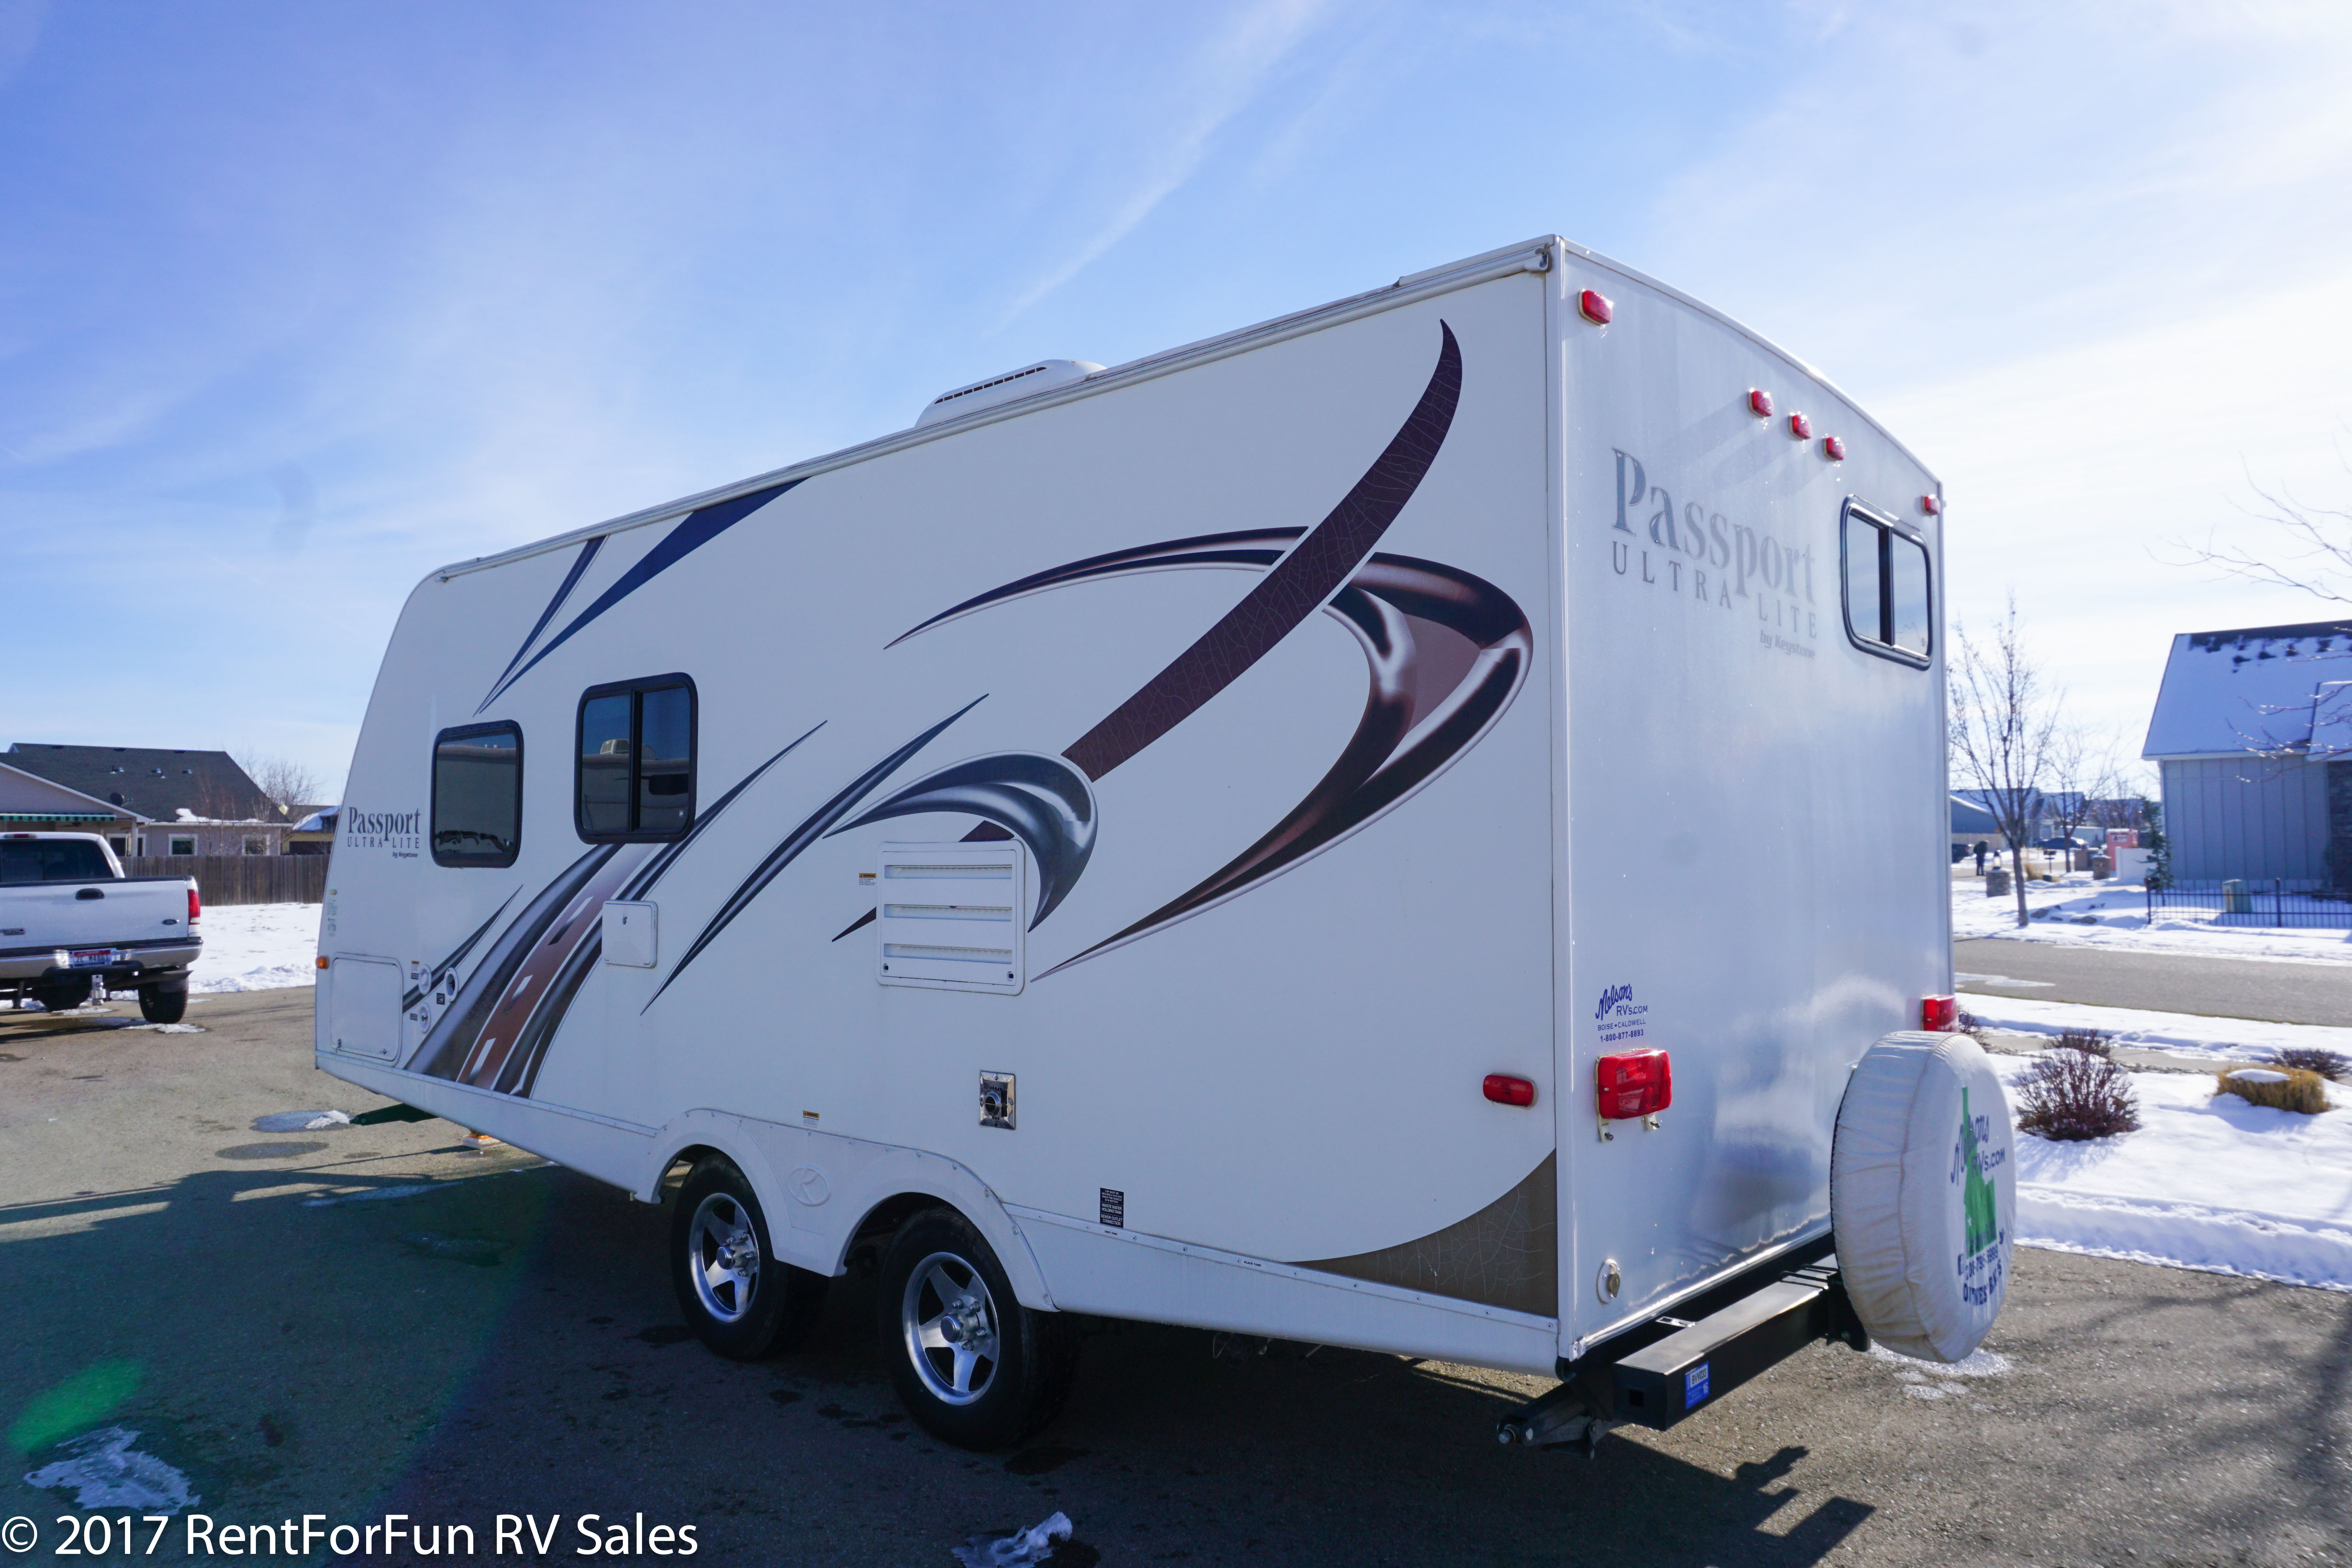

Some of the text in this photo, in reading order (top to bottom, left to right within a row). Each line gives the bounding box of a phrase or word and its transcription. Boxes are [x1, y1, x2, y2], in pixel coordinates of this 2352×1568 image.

[1611, 446, 1817, 606] Passport
[1613, 540, 1817, 639] ULTRA LITE
[1760, 629, 1815, 660] by Keystone
[348, 807, 421, 841] Passport
[348, 837, 419, 848] ULTRA LITE
[1595, 983, 1632, 1021] Nelson's
[1600, 1029, 1644, 1042] 1-800-877-8893
[1618, 1019, 1646, 1028] CALDWELL
